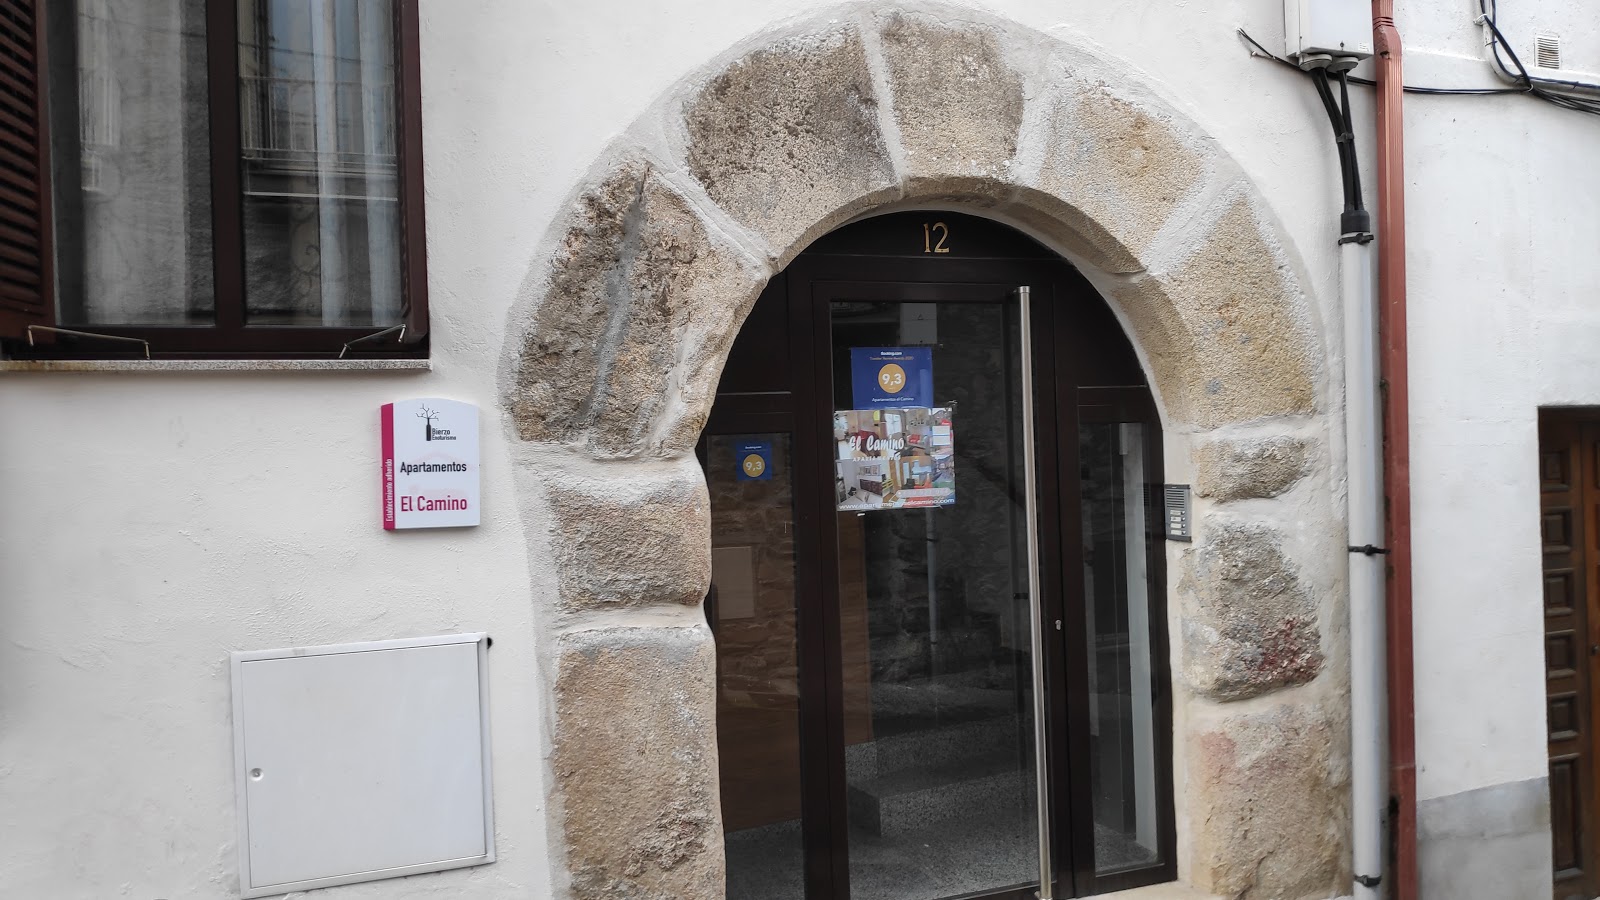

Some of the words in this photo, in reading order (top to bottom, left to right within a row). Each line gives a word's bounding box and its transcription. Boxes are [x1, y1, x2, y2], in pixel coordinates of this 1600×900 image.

[923, 222, 950, 253] 12
[882, 373, 902, 386] 9,3
[431, 428, 451, 436] Bierzo
[849, 435, 862, 451] El
[866, 434, 904, 452] Camino
[384, 458, 393, 481] adherido
[400, 461, 467, 475] Apartamentos
[745, 461, 762, 471] 9,3
[385, 482, 393, 522] Establecimiento
[401, 496, 413, 512] El
[417, 495, 468, 511] Camino
